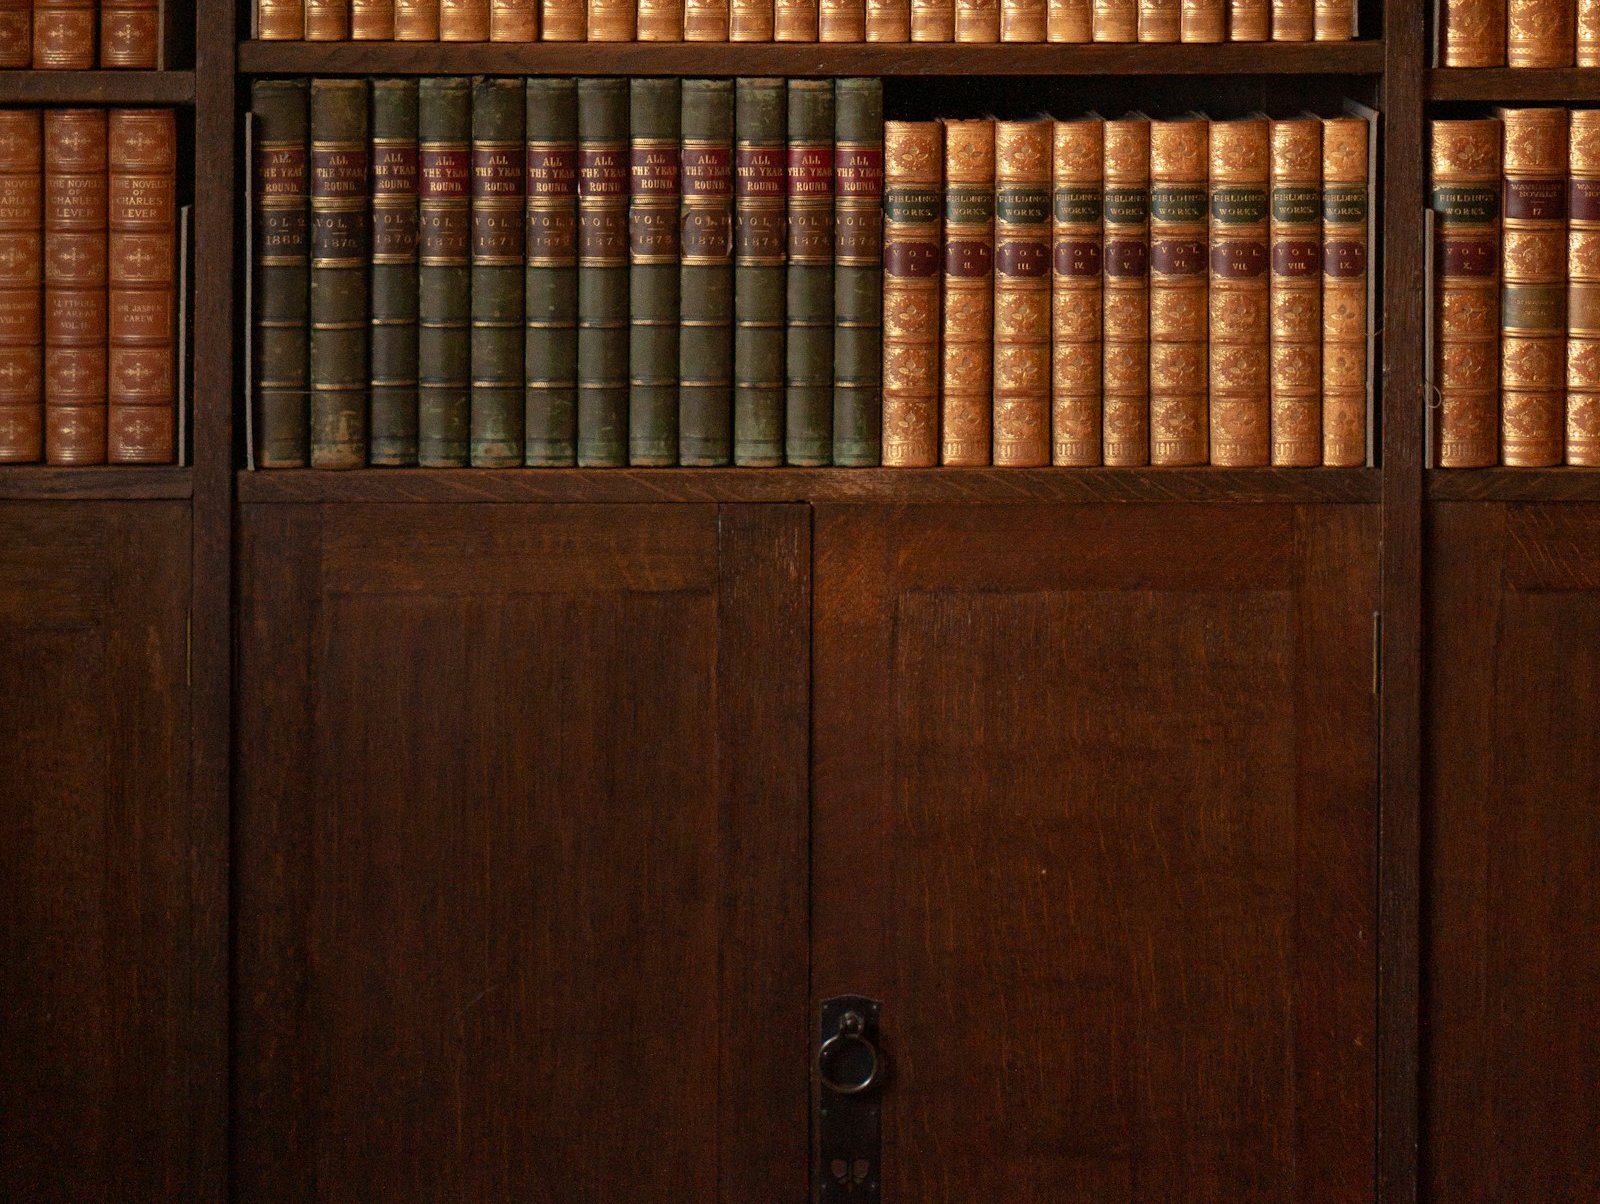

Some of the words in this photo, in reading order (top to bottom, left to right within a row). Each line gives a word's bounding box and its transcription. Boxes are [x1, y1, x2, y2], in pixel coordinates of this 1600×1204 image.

[272, 154, 291, 164] ALL
[329, 156, 349, 165] ALL
[384, 153, 403, 163] ALL
[489, 155, 509, 165] ALL
[543, 157, 563, 166] ALL
[646, 154, 666, 164] ALL
[698, 155, 718, 165] ALL
[751, 155, 771, 165] ALL
[849, 156, 869, 165] ALL
[316, 167, 336, 177] THE
[475, 167, 494, 177] THE
[530, 168, 549, 178] THE
[632, 165, 650, 175] THE
[685, 166, 704, 176] THE
[737, 166, 755, 177] THE
[836, 167, 854, 177] THE
[117, 197, 163, 205] CHARLES
[56, 209, 95, 217] LEVER
[121, 209, 157, 217] LEVER
